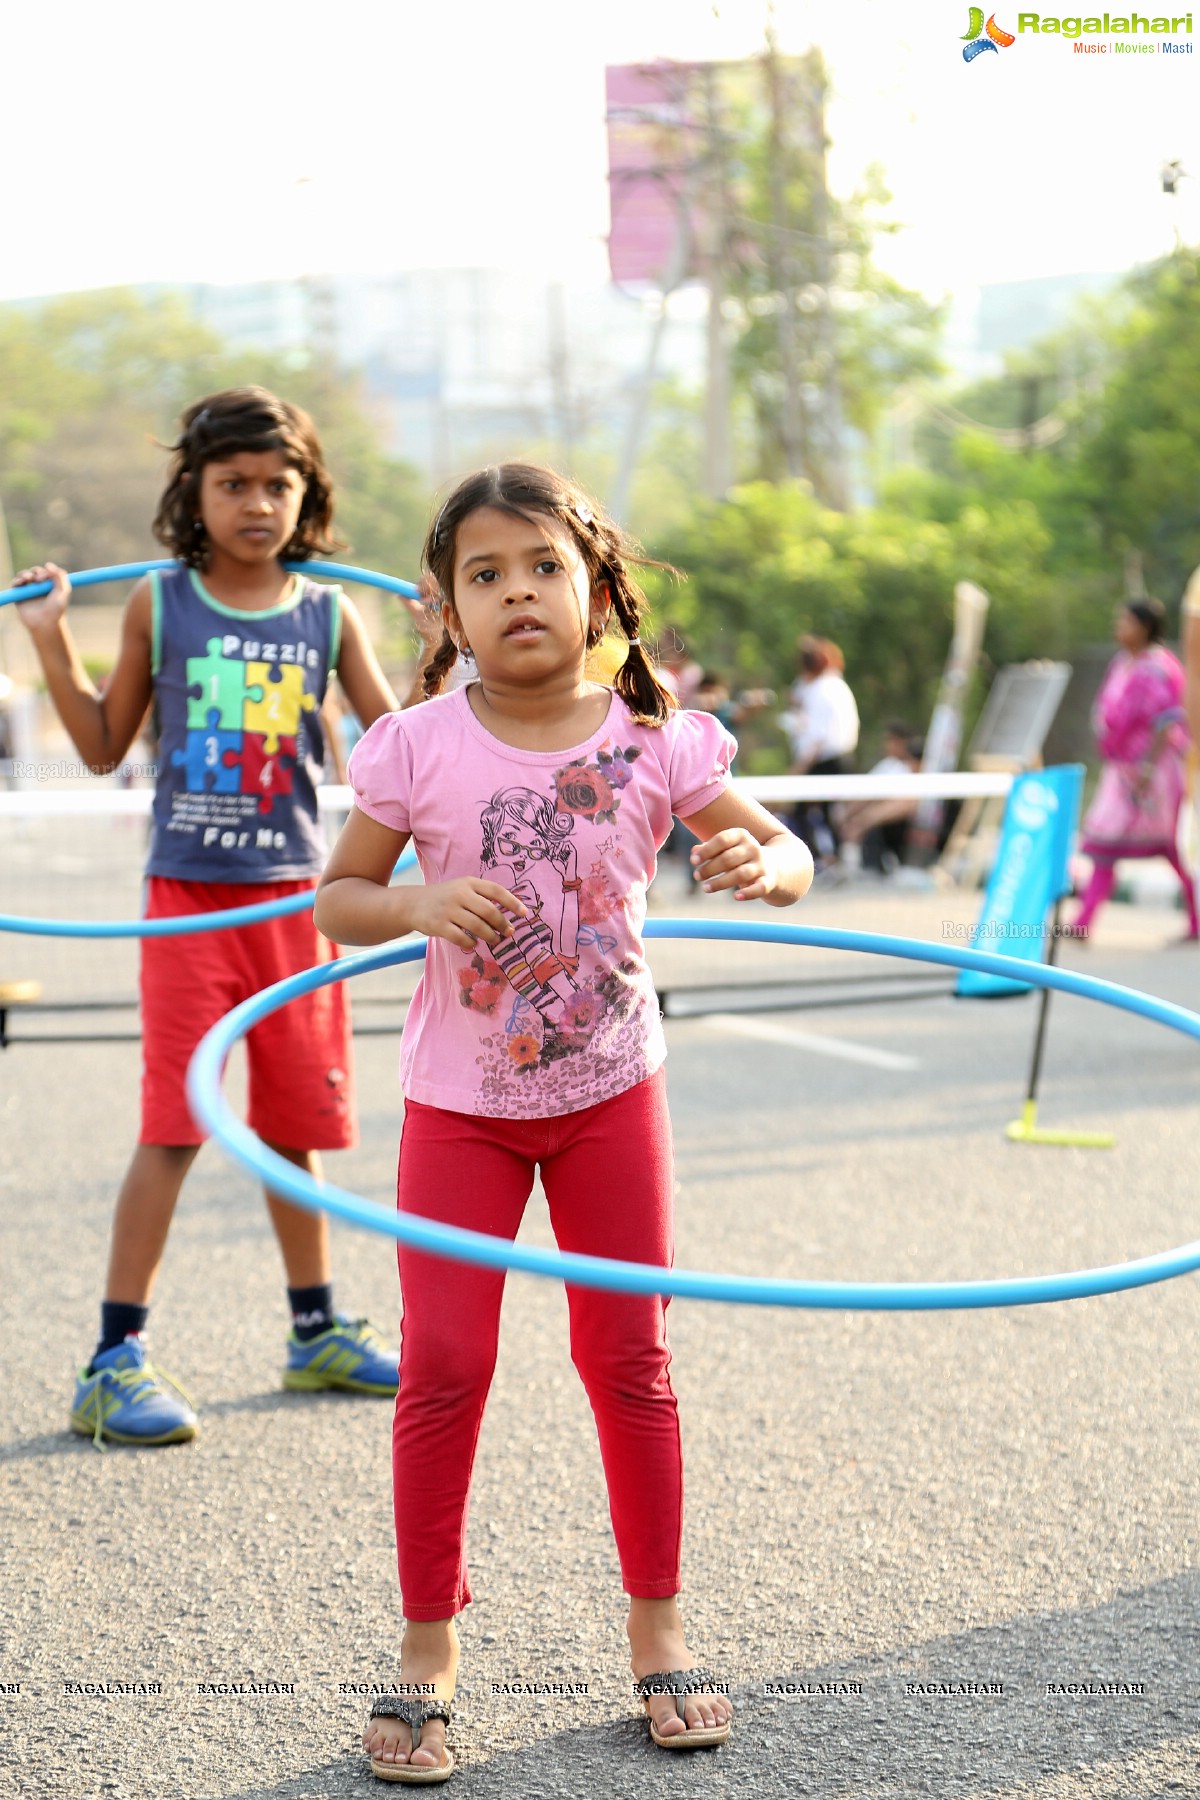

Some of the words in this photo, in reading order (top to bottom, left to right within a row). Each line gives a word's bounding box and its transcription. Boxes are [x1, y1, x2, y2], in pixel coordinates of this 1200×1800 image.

[222, 634, 319, 669] Puzzle
[209, 674, 220, 703] 1
[267, 692, 282, 720] 2
[204, 736, 219, 767] 3
[258, 760, 274, 788] 4
[203, 827, 251, 849] For
[256, 828, 287, 850] Me
